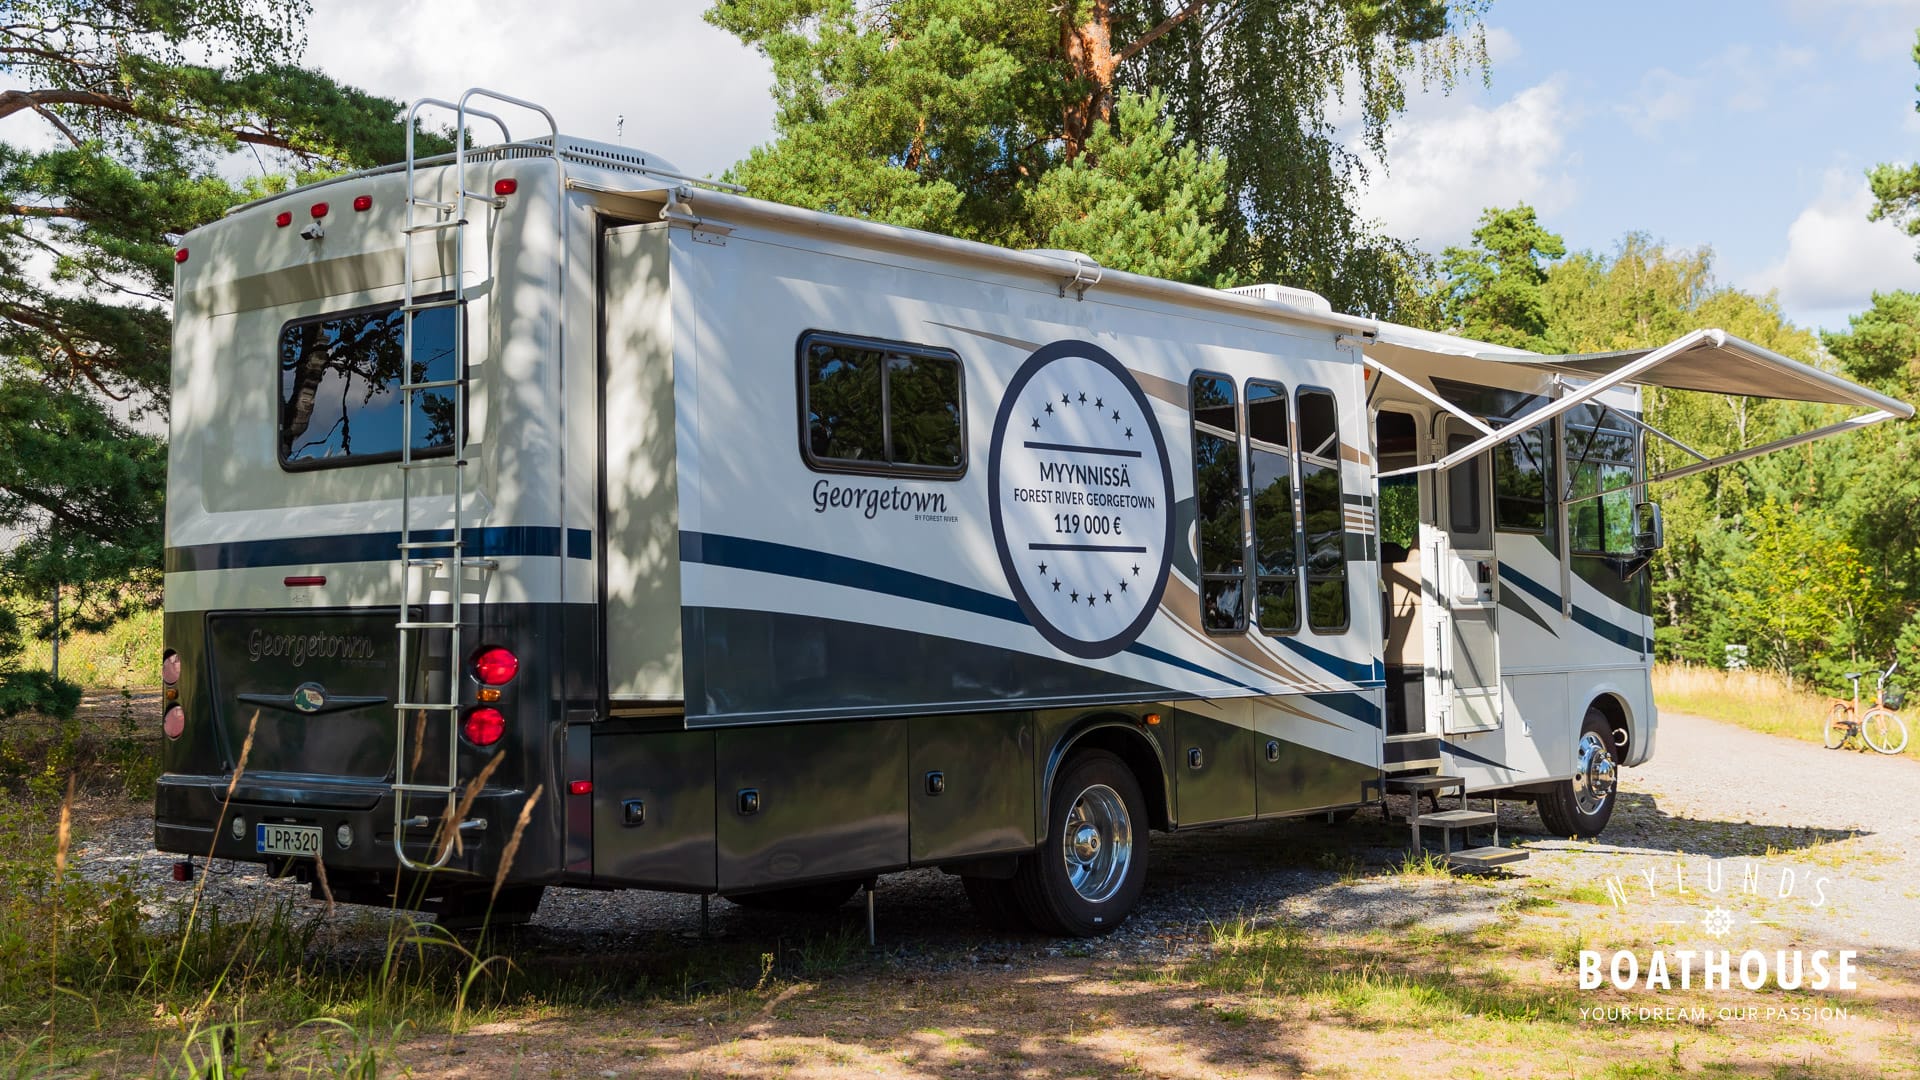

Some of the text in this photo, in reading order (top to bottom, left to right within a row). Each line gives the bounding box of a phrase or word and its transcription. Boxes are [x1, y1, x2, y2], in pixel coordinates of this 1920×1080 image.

[812, 479, 947, 520] Georgetown
[922, 514, 943, 522] FOREST
[248, 628, 375, 667] Georgetown
[267, 830, 319, 852] LPR-320
